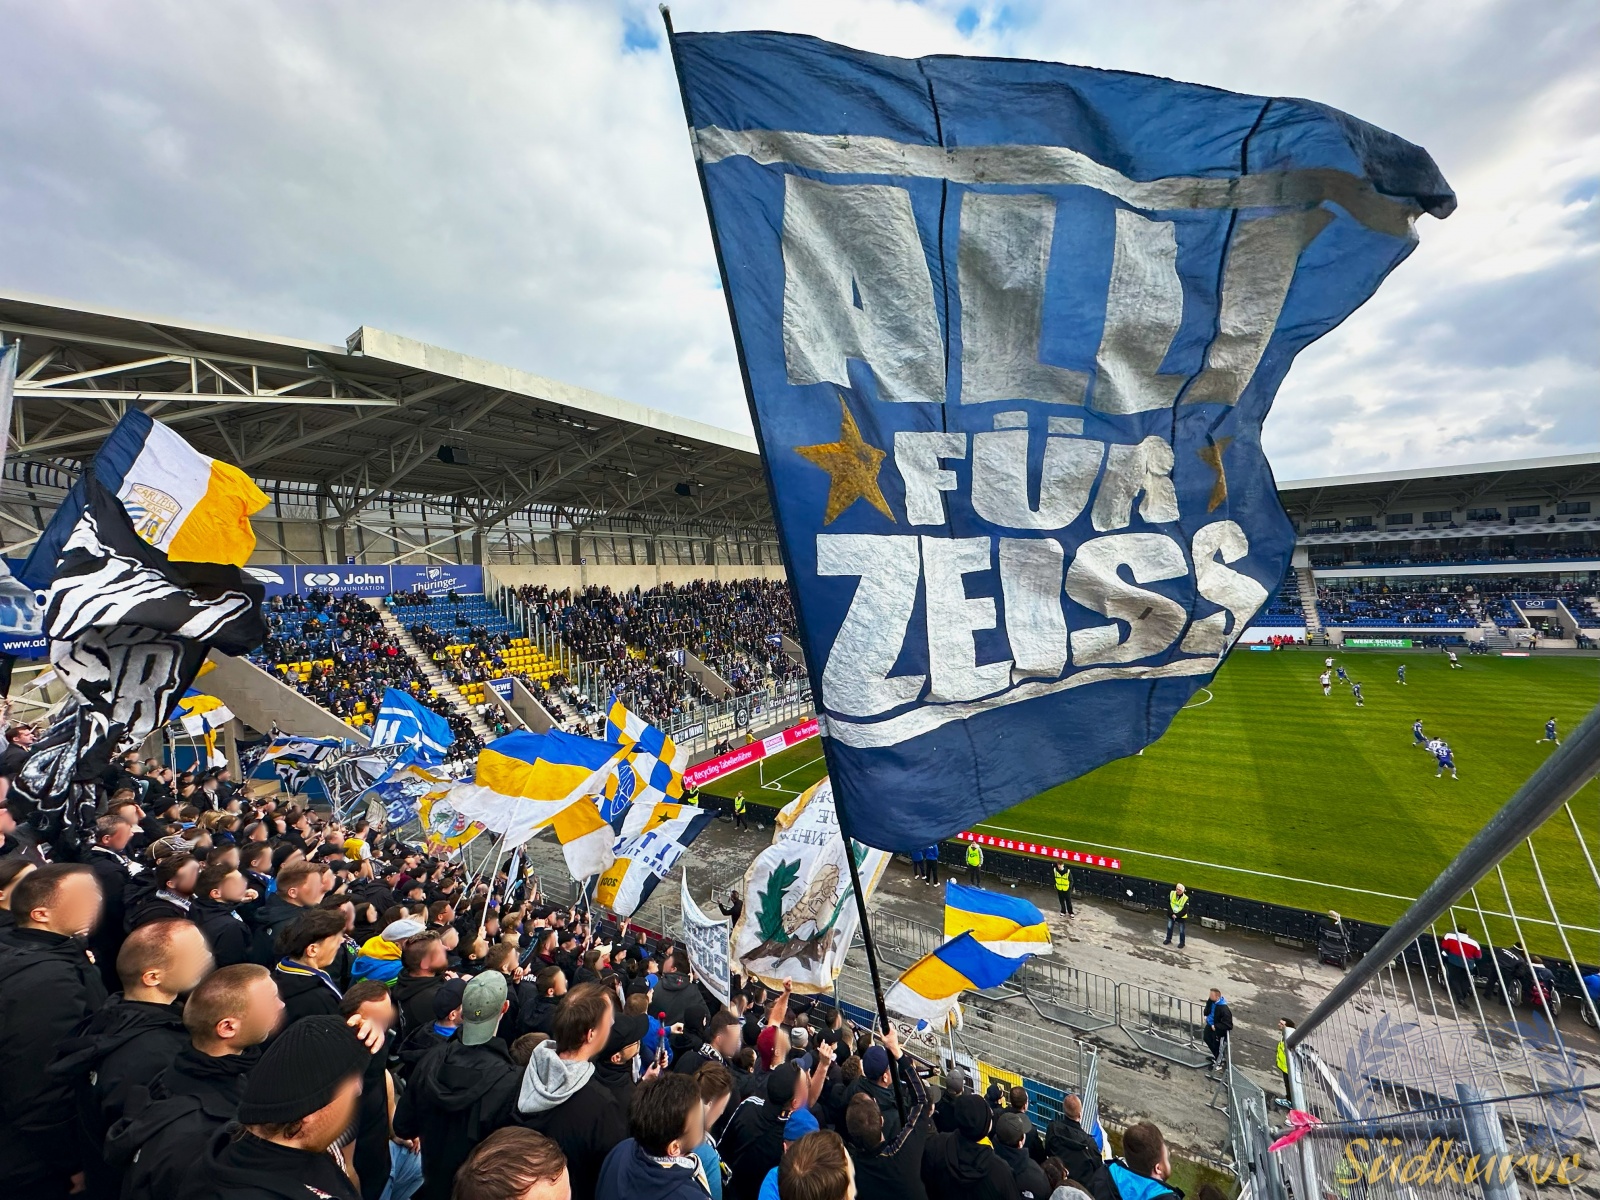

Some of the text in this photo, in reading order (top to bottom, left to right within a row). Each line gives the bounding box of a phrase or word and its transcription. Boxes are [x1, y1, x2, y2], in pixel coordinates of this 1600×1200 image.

[894, 411, 1180, 532] FÜR
[344, 573, 385, 585] John
[411, 577, 457, 593] Thüringer
[816, 520, 1269, 717] ZEISS
